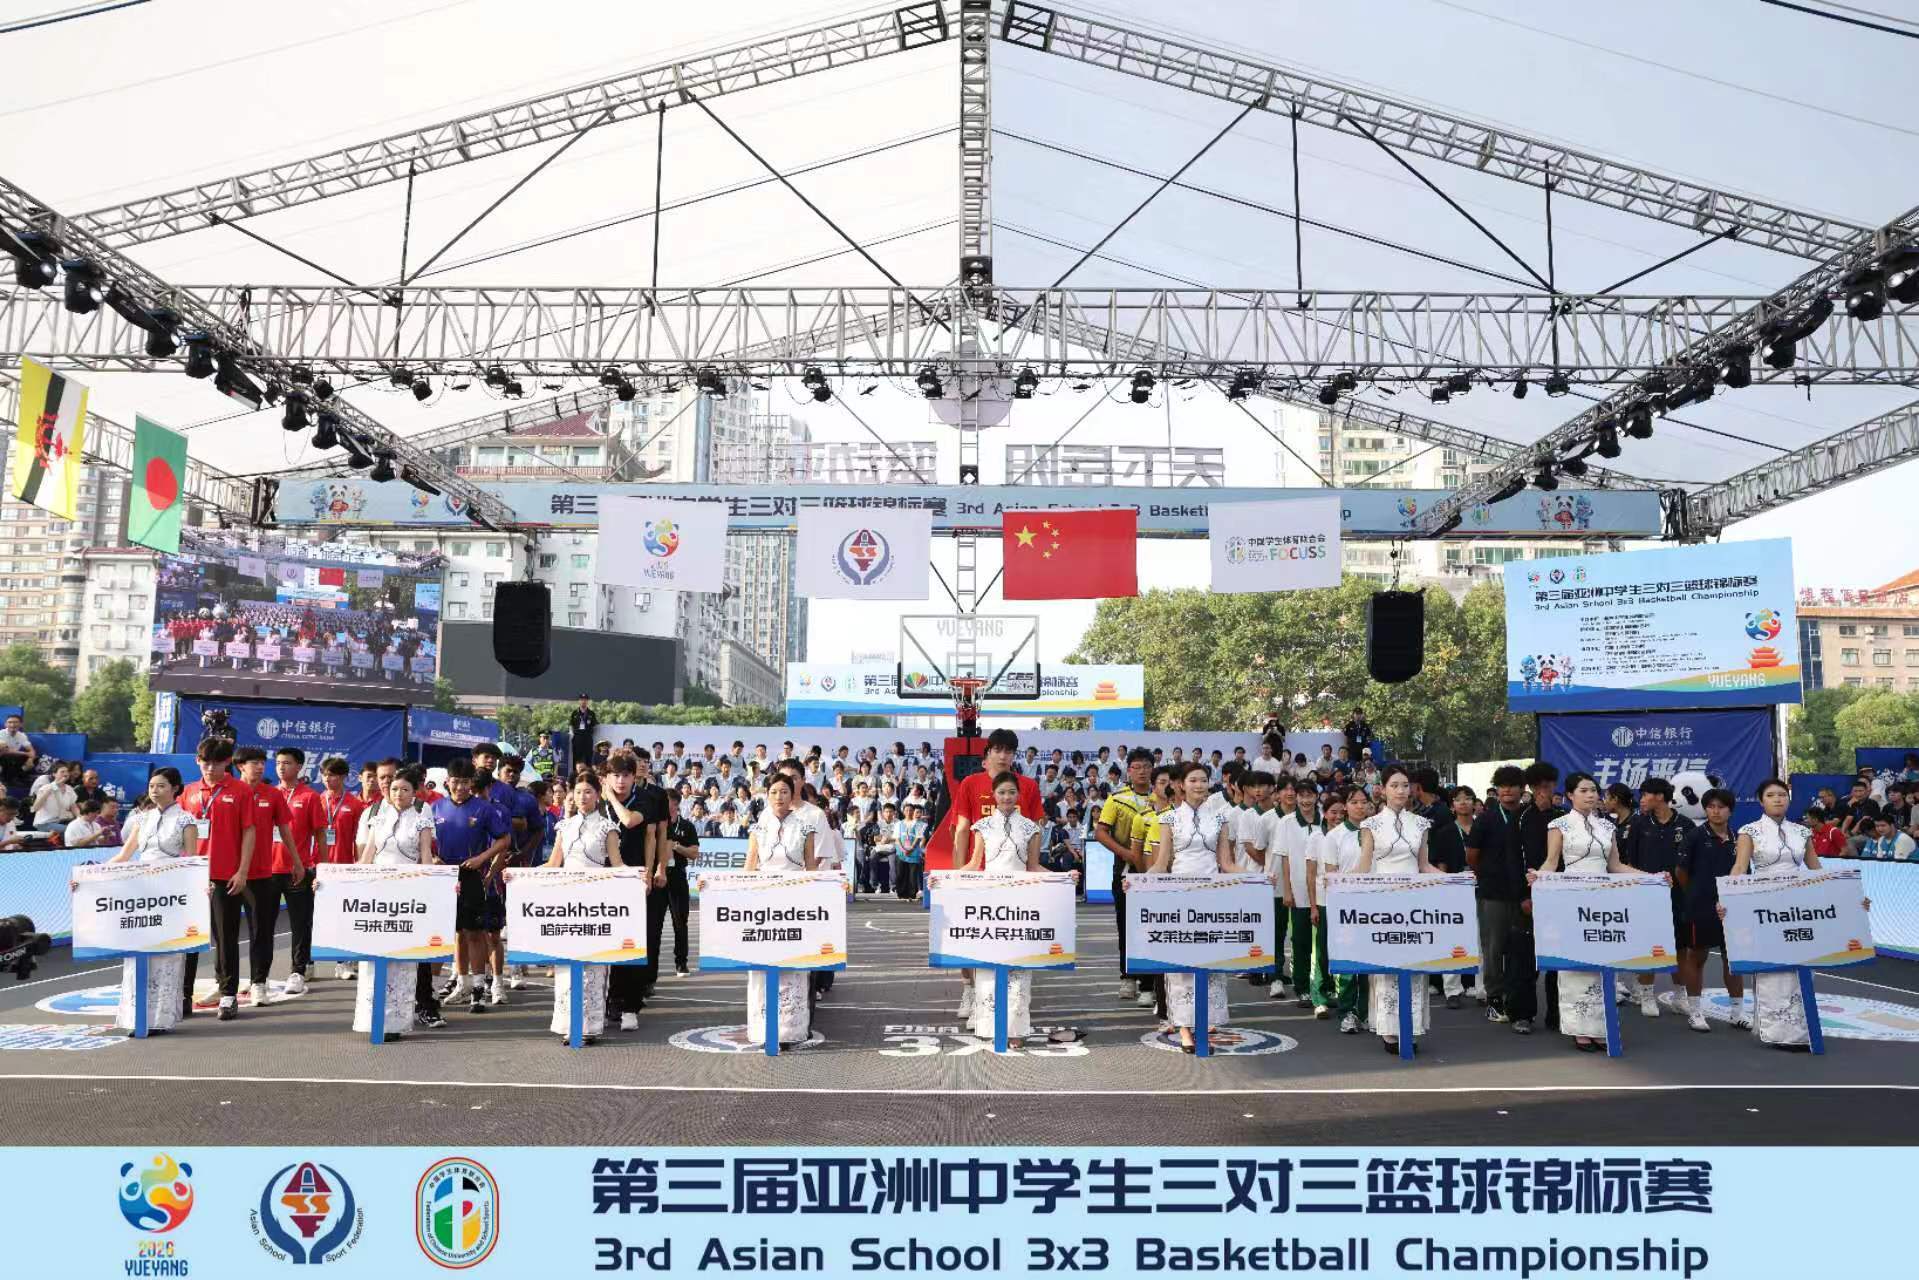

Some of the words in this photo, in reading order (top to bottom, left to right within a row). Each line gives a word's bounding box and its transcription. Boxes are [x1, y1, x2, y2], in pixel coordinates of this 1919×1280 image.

[956, 502, 984, 514] 3rd
[1269, 545, 1326, 560] FOCUSS
[1708, 672, 1766, 688] YUEYANG
[281, 719, 337, 734] 中信银行
[1635, 726, 1694, 740] 中信银行
[95, 894, 187, 914] Singapore
[343, 898, 427, 917] Malaysia
[522, 902, 629, 918] Kazakhstan
[716, 906, 829, 926] Bangladesh
[965, 905, 1040, 921] P.R.China
[1140, 908, 1181, 924] Brunei
[1187, 908, 1262, 924] Darussalam
[1339, 908, 1464, 927] Macao,China
[1577, 906, 1630, 926] Nepal
[1753, 904, 1837, 925] Thailand
[120, 915, 163, 930] 新加坡
[353, 919, 414, 933] 马来西亚
[540, 923, 612, 937] 哈萨克斯坦
[741, 927, 802, 942] 孟加拉国
[949, 926, 1055, 941] 中华人民共和国
[1147, 930, 1255, 944] 文莱达鲁萨兰国
[1371, 931, 1434, 945] 中国澳门
[1582, 928, 1627, 943] 尼泊尔
[1782, 927, 1815, 942] 泰国
